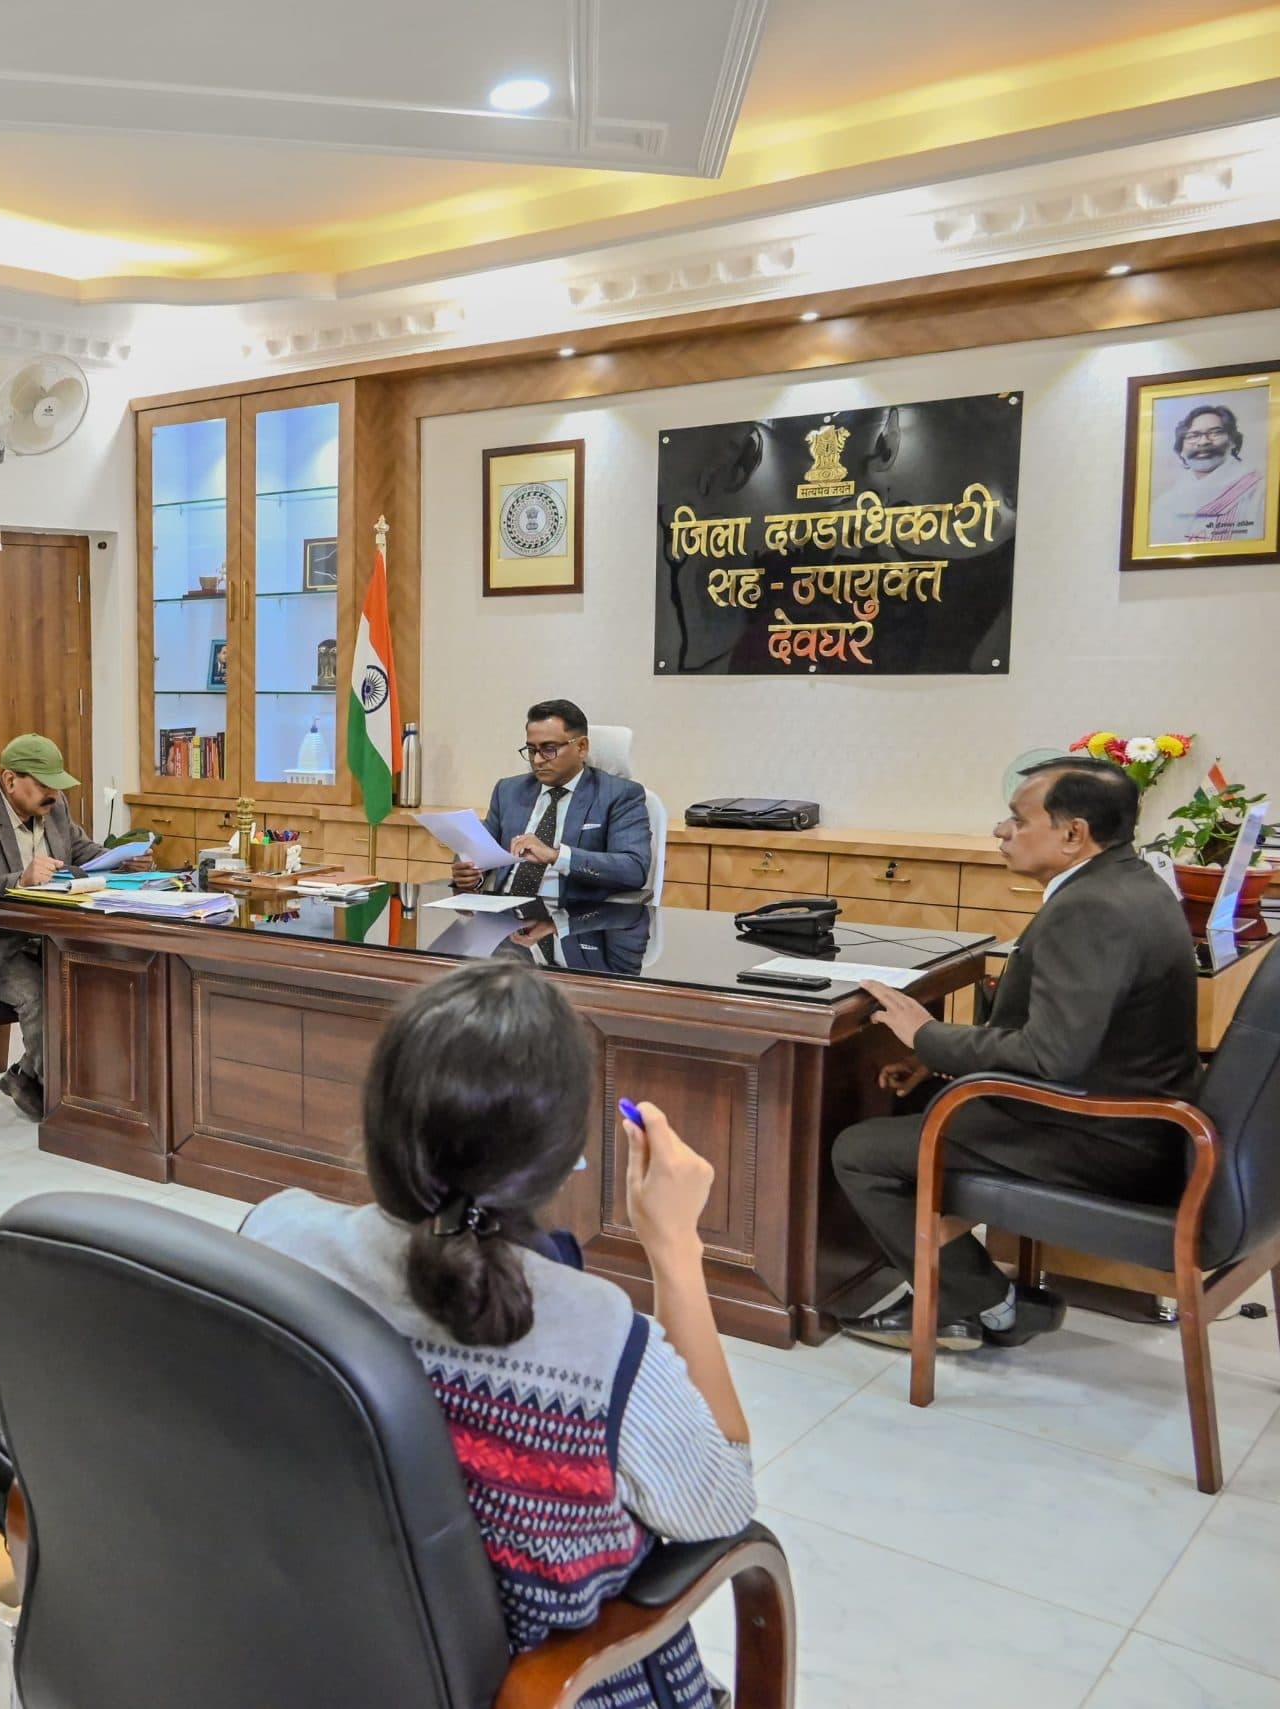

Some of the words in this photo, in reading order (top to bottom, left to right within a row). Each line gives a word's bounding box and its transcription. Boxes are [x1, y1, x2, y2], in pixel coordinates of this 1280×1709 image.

[670, 506, 751, 559] जिला
[765, 482, 1000, 555] दण्डाधिकारी
[708, 568, 765, 608] सह
[791, 560, 949, 621] उपायुक्त
[768, 607, 874, 665] देवघर
